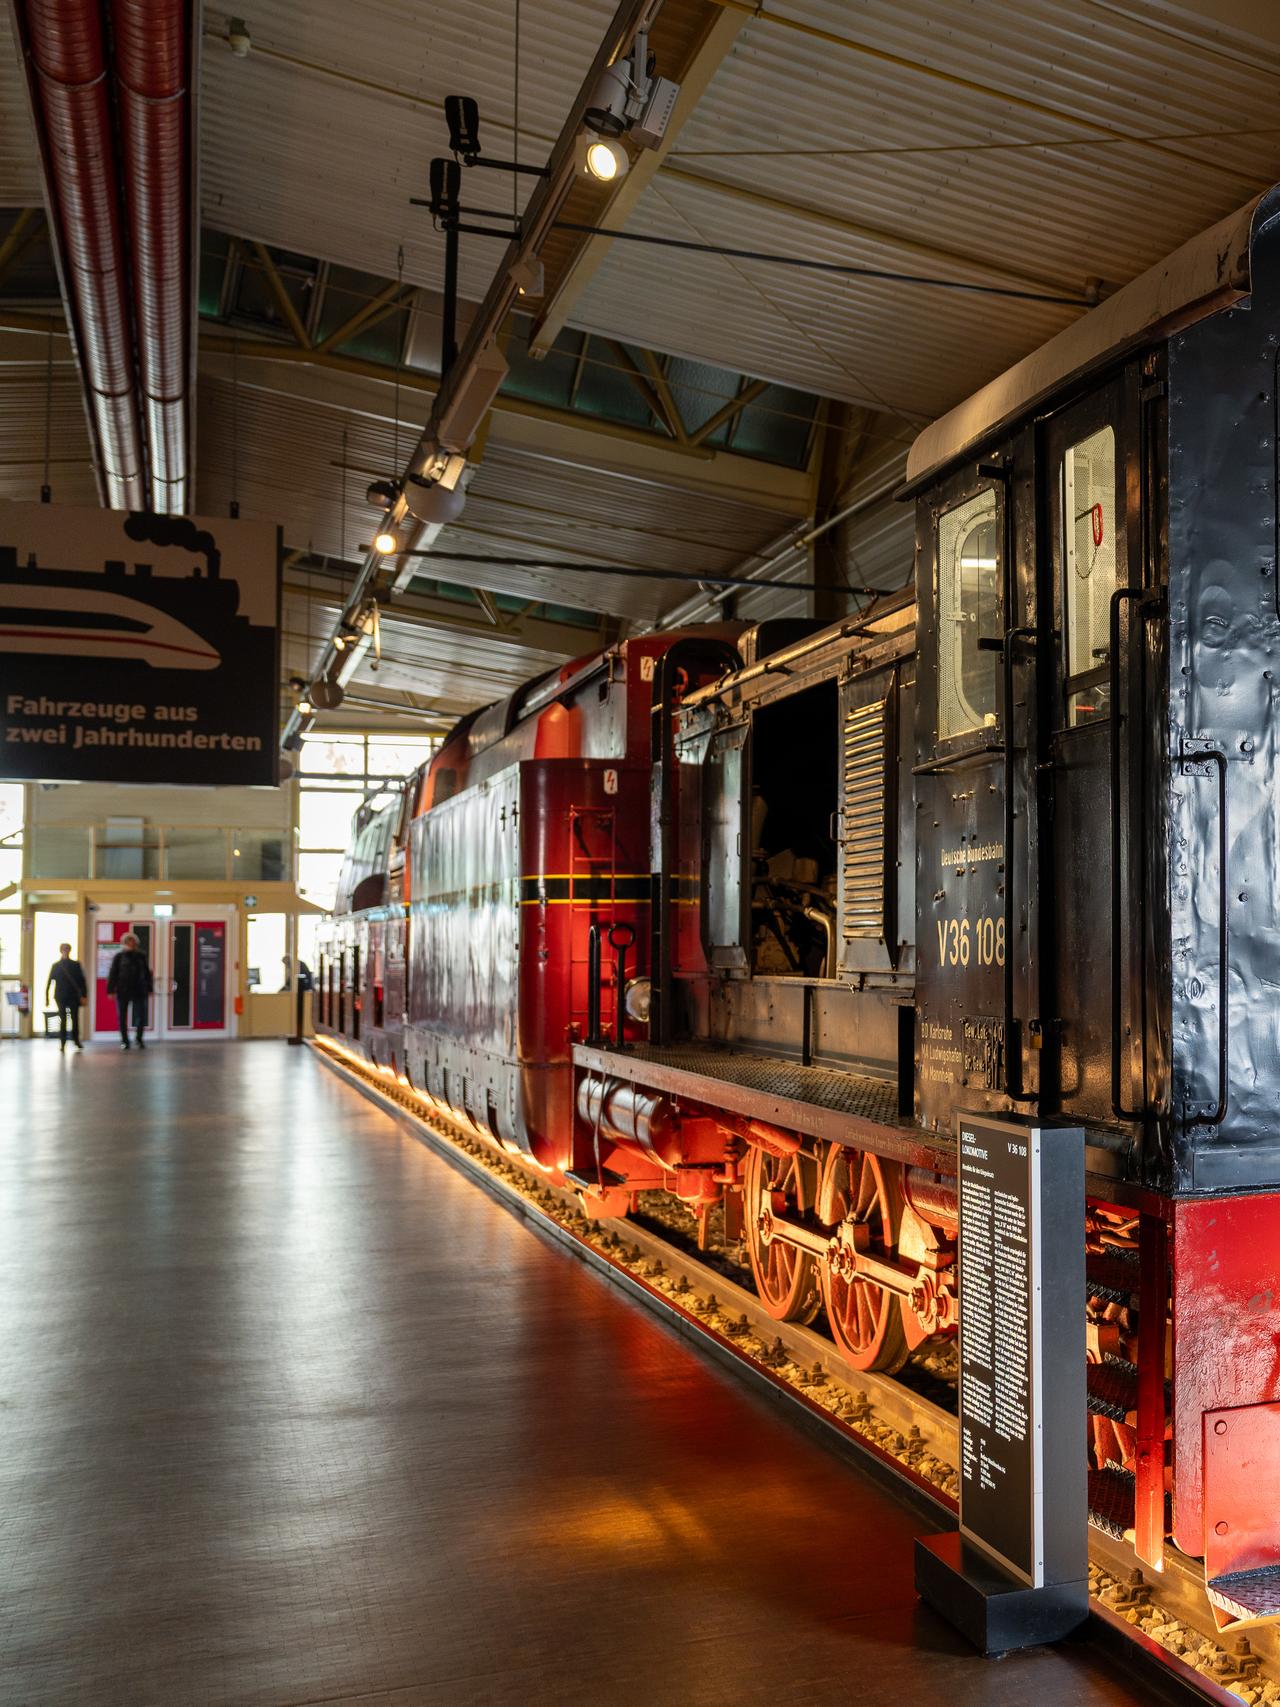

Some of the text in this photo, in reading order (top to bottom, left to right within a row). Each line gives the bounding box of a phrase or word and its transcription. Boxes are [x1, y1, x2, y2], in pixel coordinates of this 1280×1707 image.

[7, 695, 199, 722] Fahrzeuge aus
[5, 724, 262, 751] zwei Jahrhunderten
[941, 841, 1004, 867] Deutsche Bundesbahn
[937, 917, 1005, 967] V36 108
[930, 1022, 953, 1041] Karlsruhe
[930, 1043, 962, 1066] Ludwigshafen
[930, 1065, 954, 1085] Mannheim
